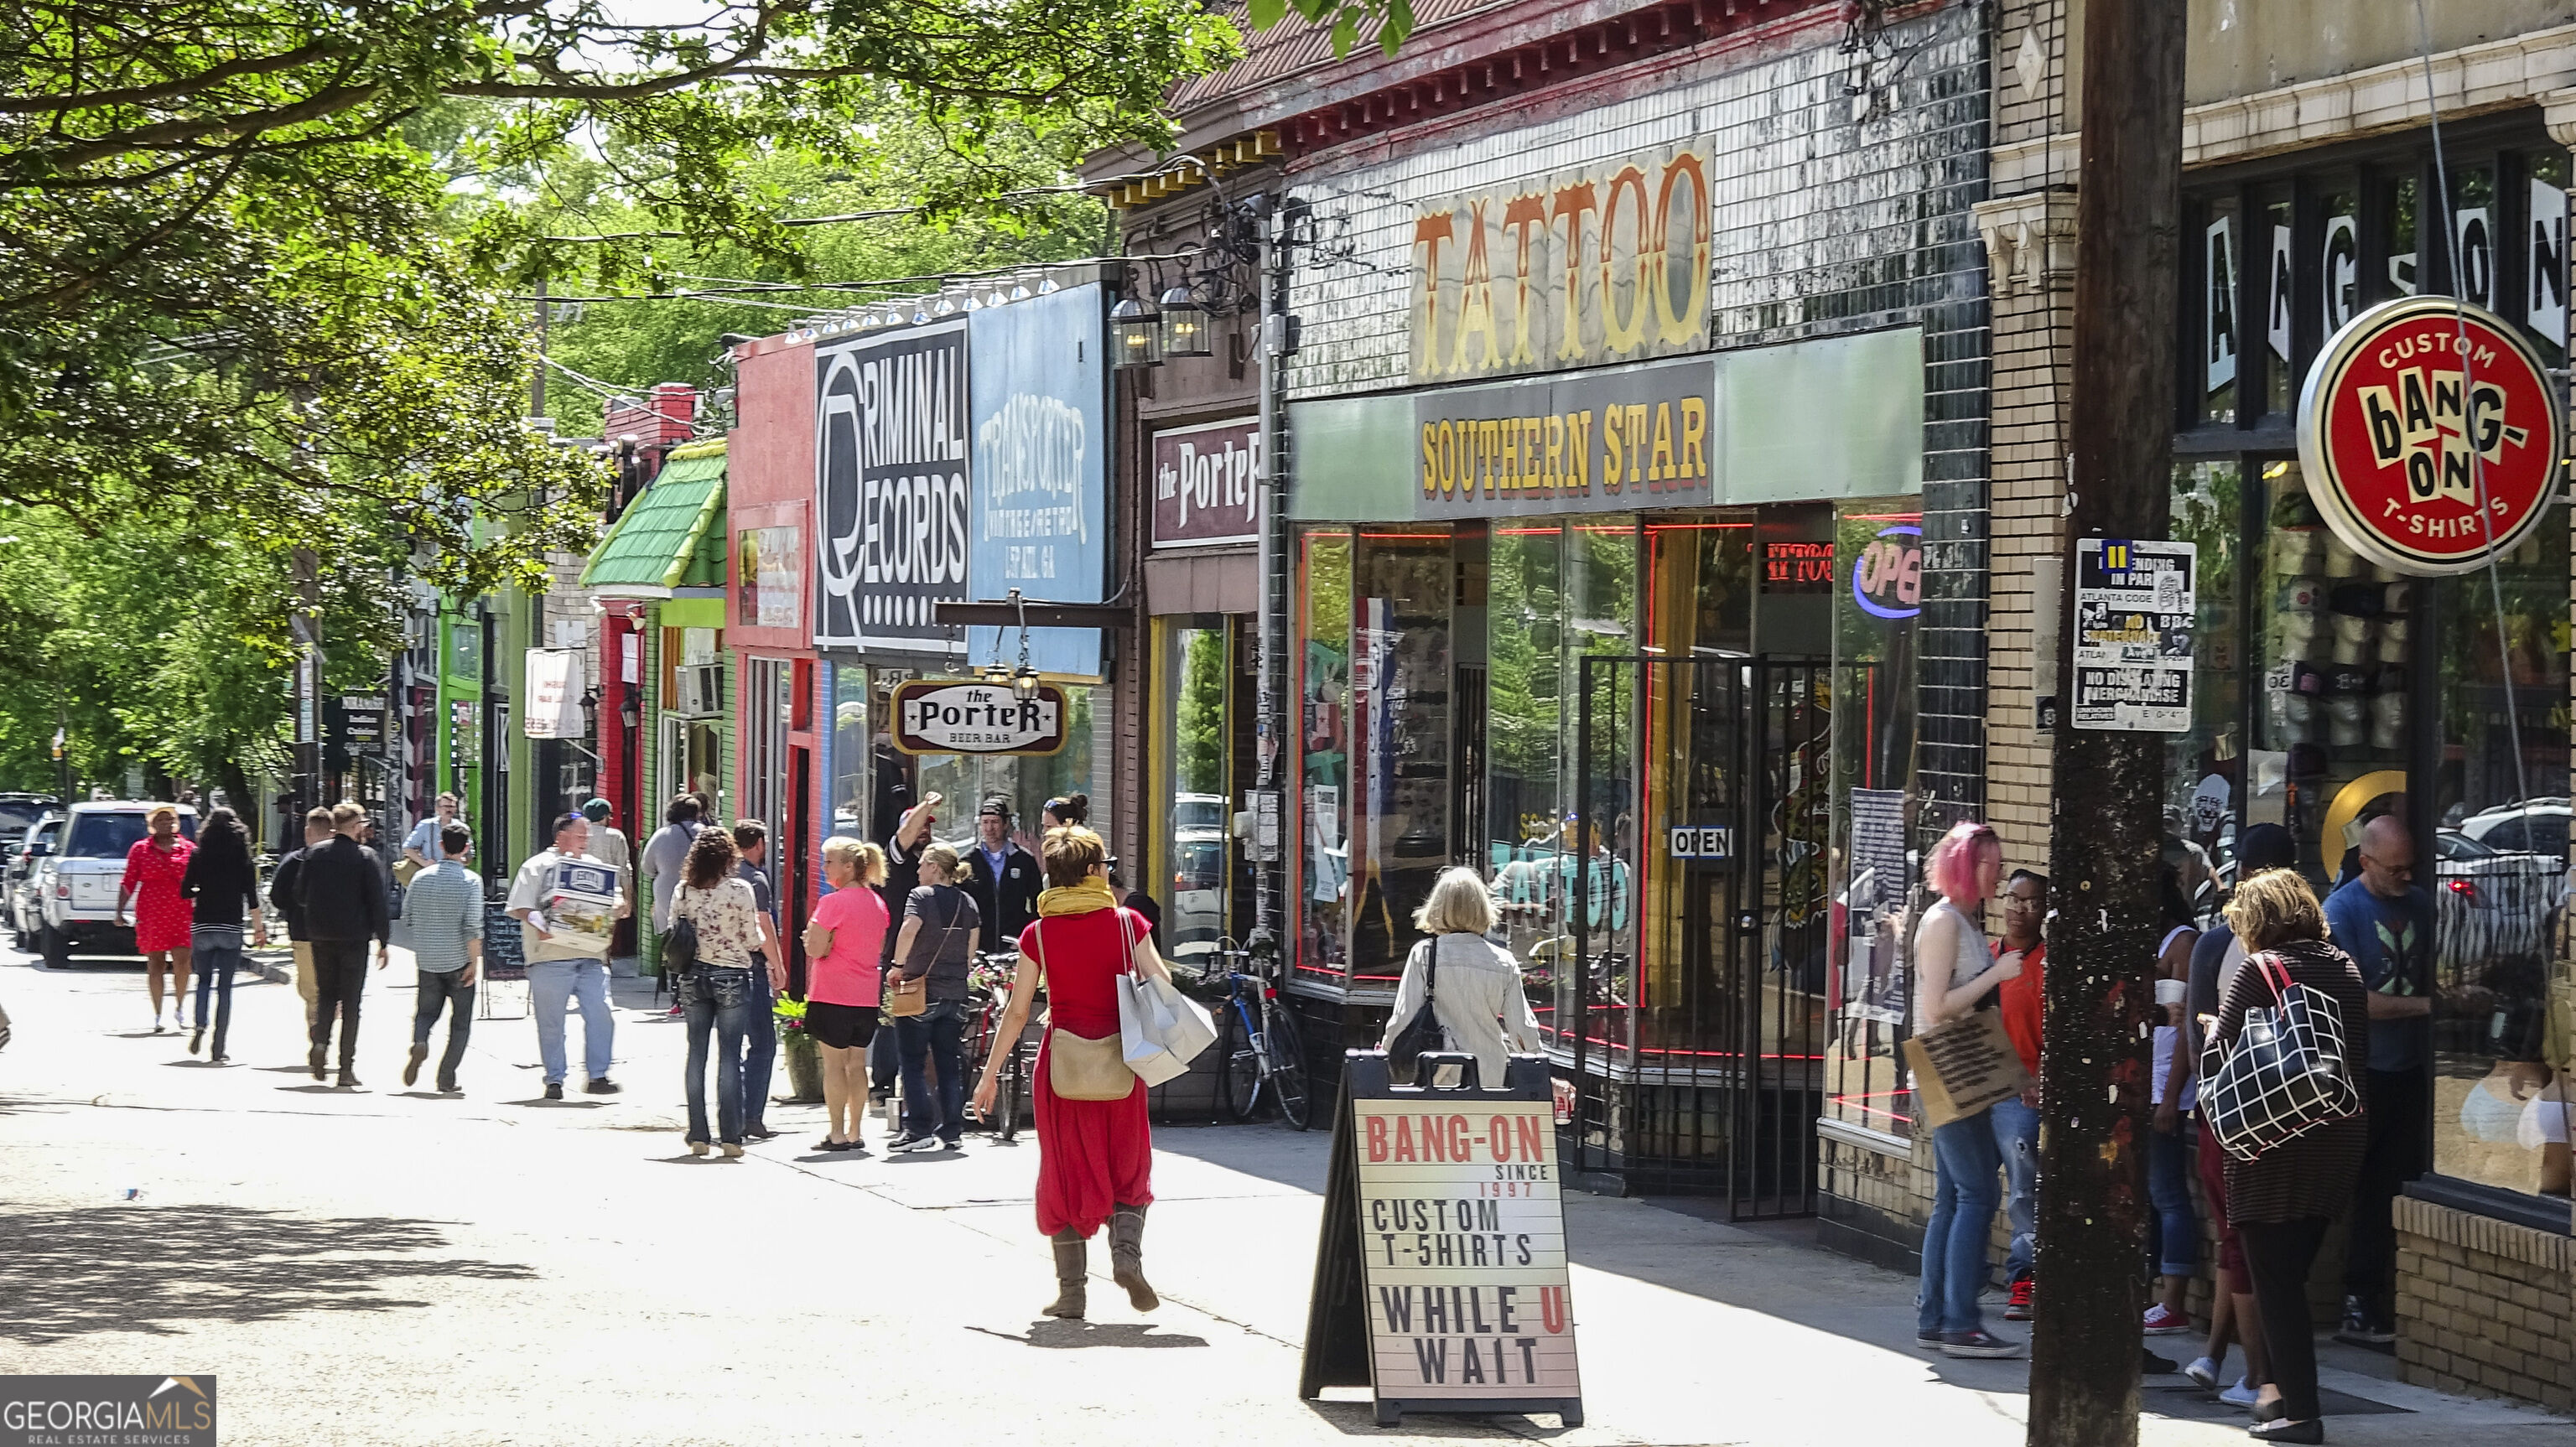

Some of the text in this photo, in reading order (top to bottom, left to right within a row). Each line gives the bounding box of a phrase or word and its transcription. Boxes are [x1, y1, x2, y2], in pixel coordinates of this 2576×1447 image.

[1414, 152, 1709, 377] TATTOO
[2378, 332, 2496, 369] CUSTOM
[1422, 397, 1707, 500] SOUTHERN STAR
[1158, 462, 1178, 500] the
[2409, 450, 2472, 498] ON
[2382, 495, 2510, 538] T-SHIRTS
[2111, 573, 2126, 585] IN
[2080, 593, 2153, 604] ATLANTA CODE
[966, 689, 993, 703] the
[2085, 672, 2105, 686] NO
[949, 733, 1010, 744] BEER BAR
[1676, 832, 1728, 853] OPEN
[1491, 840, 1628, 931] TATTOO
[1366, 1114, 1544, 1163] BANG-ON
[1479, 1182, 1531, 1197] 1997
[1495, 1164, 1548, 1180] SINCE
[1372, 1199, 1499, 1232] CUSTOM
[1379, 1286, 1566, 1335] WHILE U
[1414, 1338, 1538, 1384] WAIT
